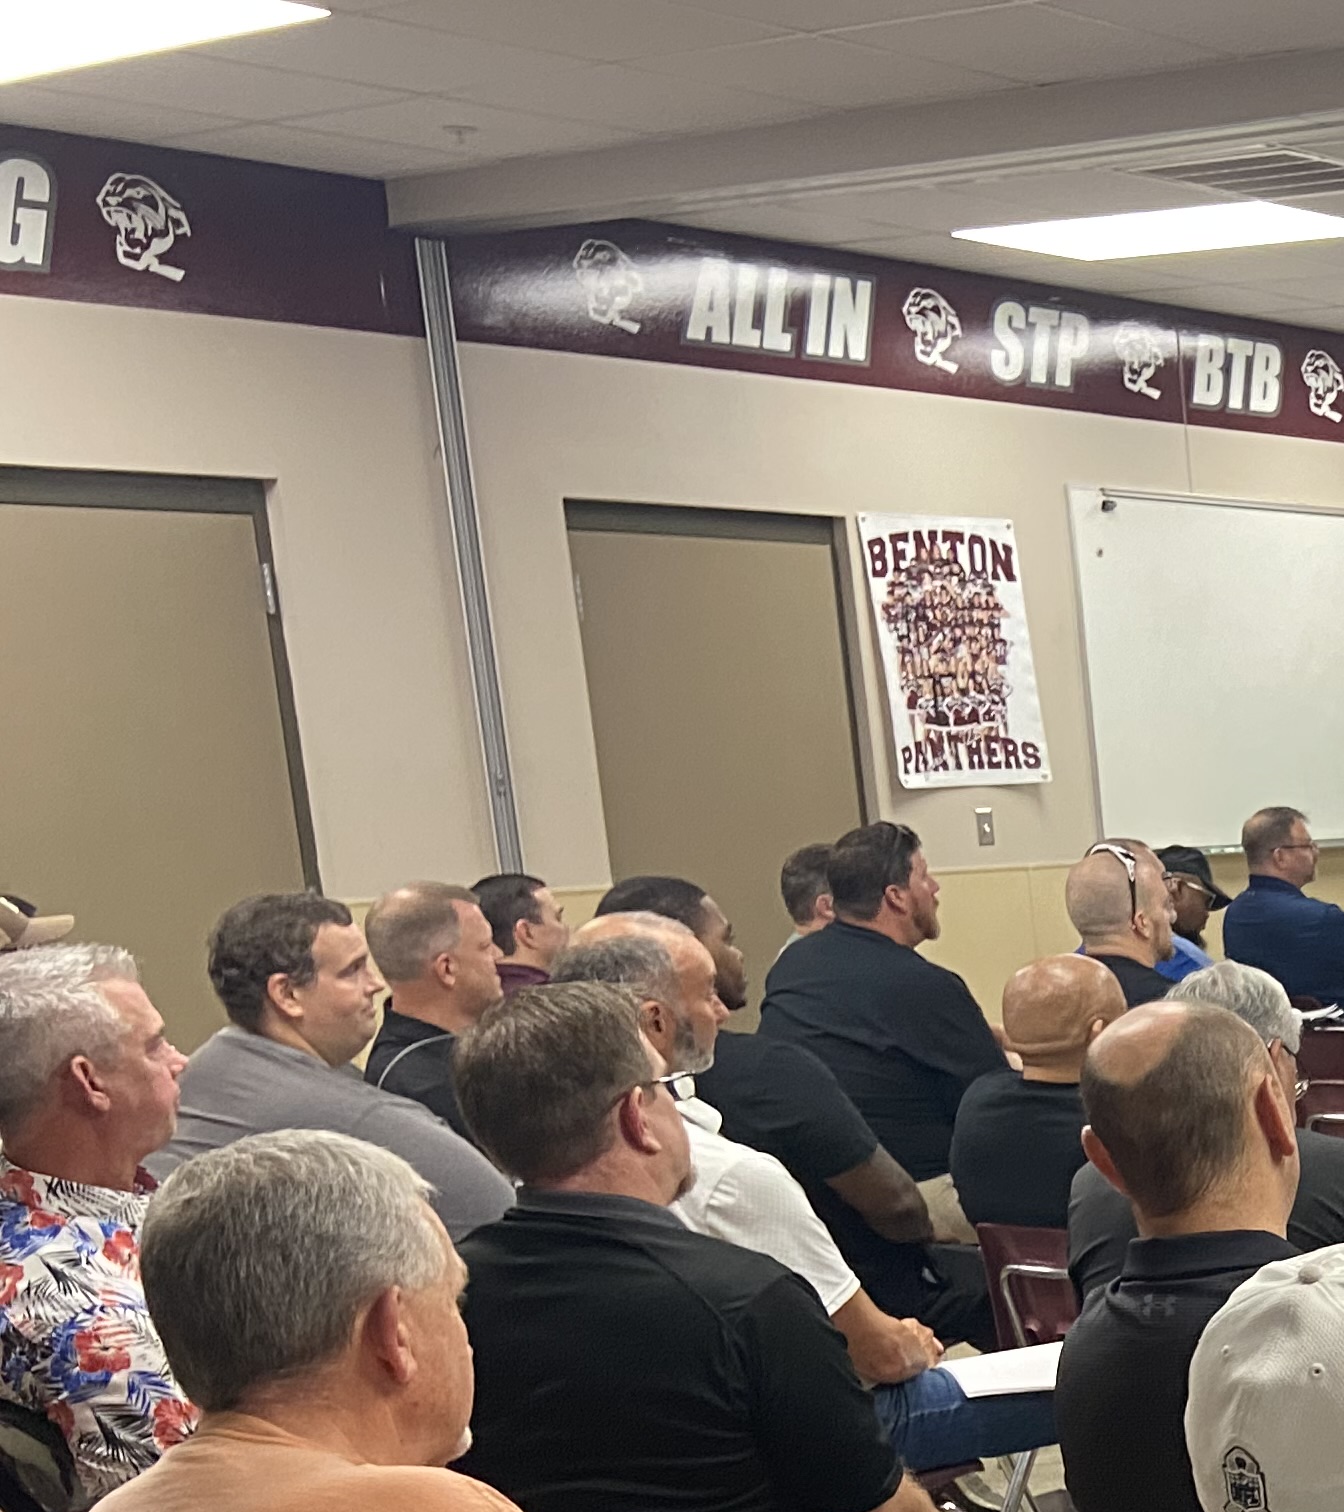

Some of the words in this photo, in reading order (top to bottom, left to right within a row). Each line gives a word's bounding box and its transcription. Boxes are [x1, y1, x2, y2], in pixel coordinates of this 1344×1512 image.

[687, 256, 794, 353] ALL
[806, 274, 872, 361] IN
[990, 302, 1089, 388] STP
[1192, 334, 1283, 414] BTB
[867, 529, 1018, 582] BENTON
[901, 730, 1042, 775] PANTHERS
